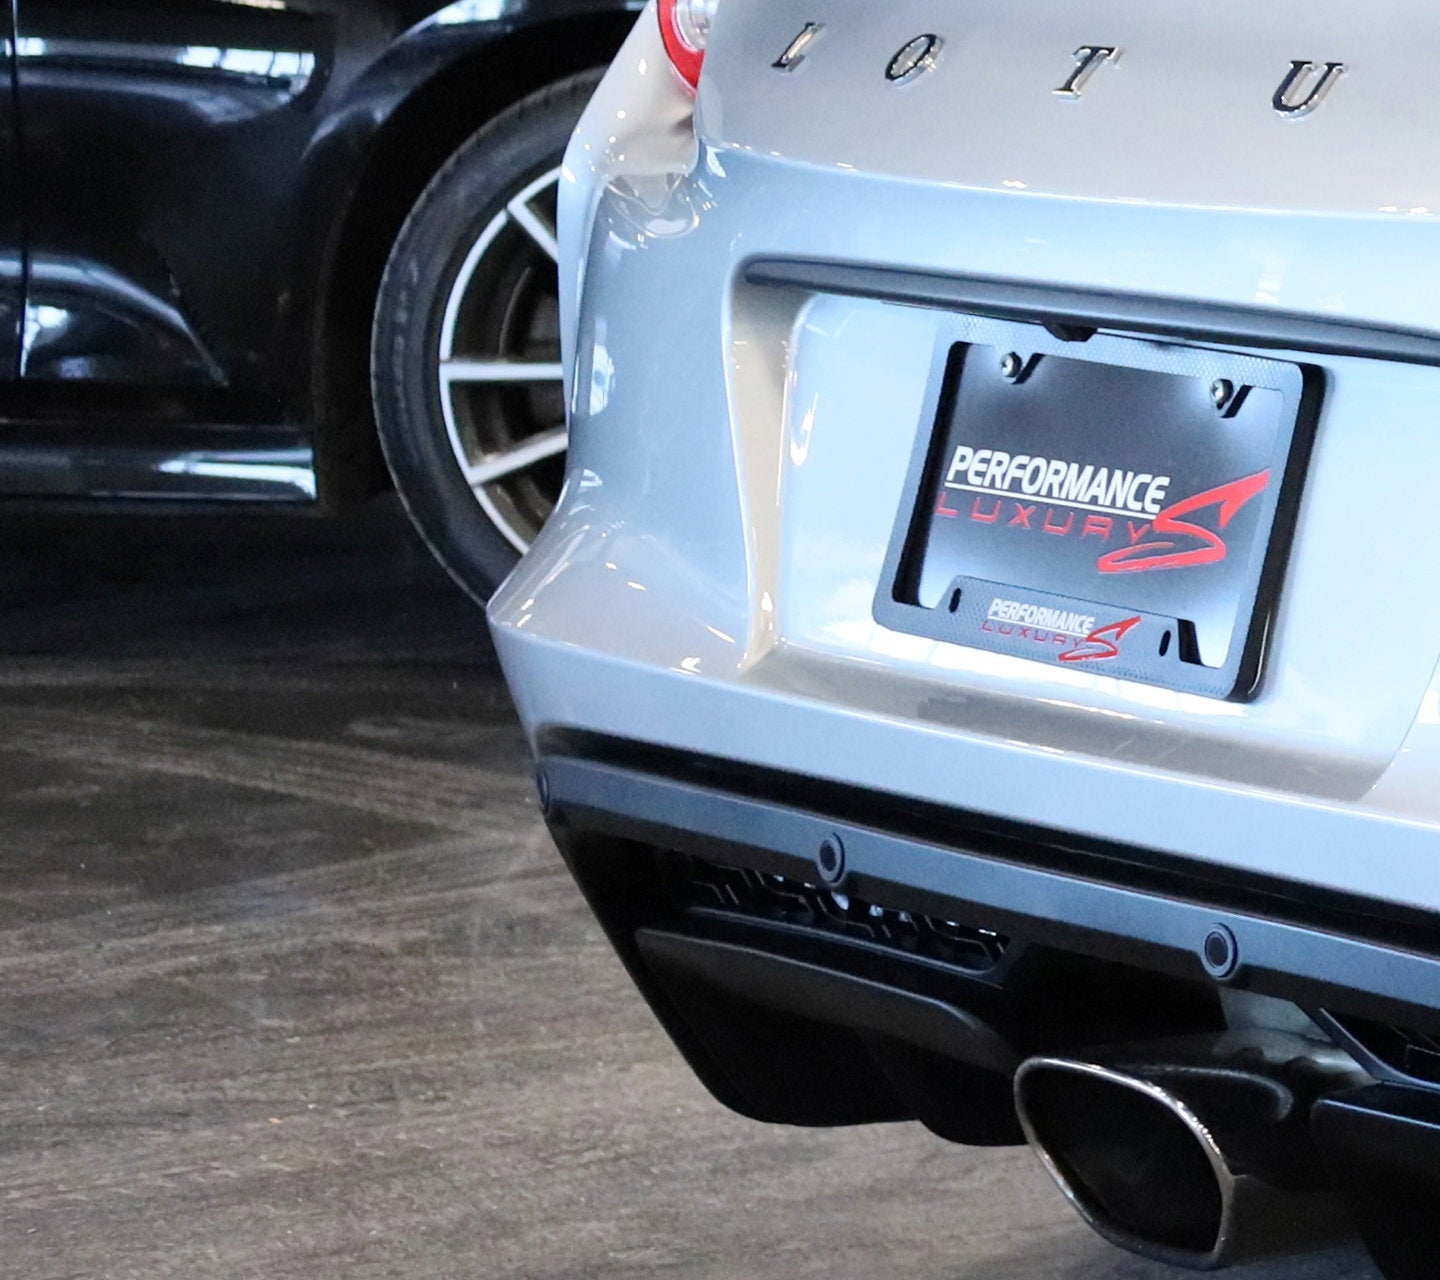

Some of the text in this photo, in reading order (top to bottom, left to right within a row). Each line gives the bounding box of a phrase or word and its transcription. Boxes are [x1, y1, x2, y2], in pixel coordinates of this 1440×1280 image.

[946, 444, 1170, 512] PERFORMANCE
[936, 491, 1152, 543] LUXURY
[982, 621, 1082, 647] LUXURY
[987, 597, 1096, 635] PERFORMANCE
